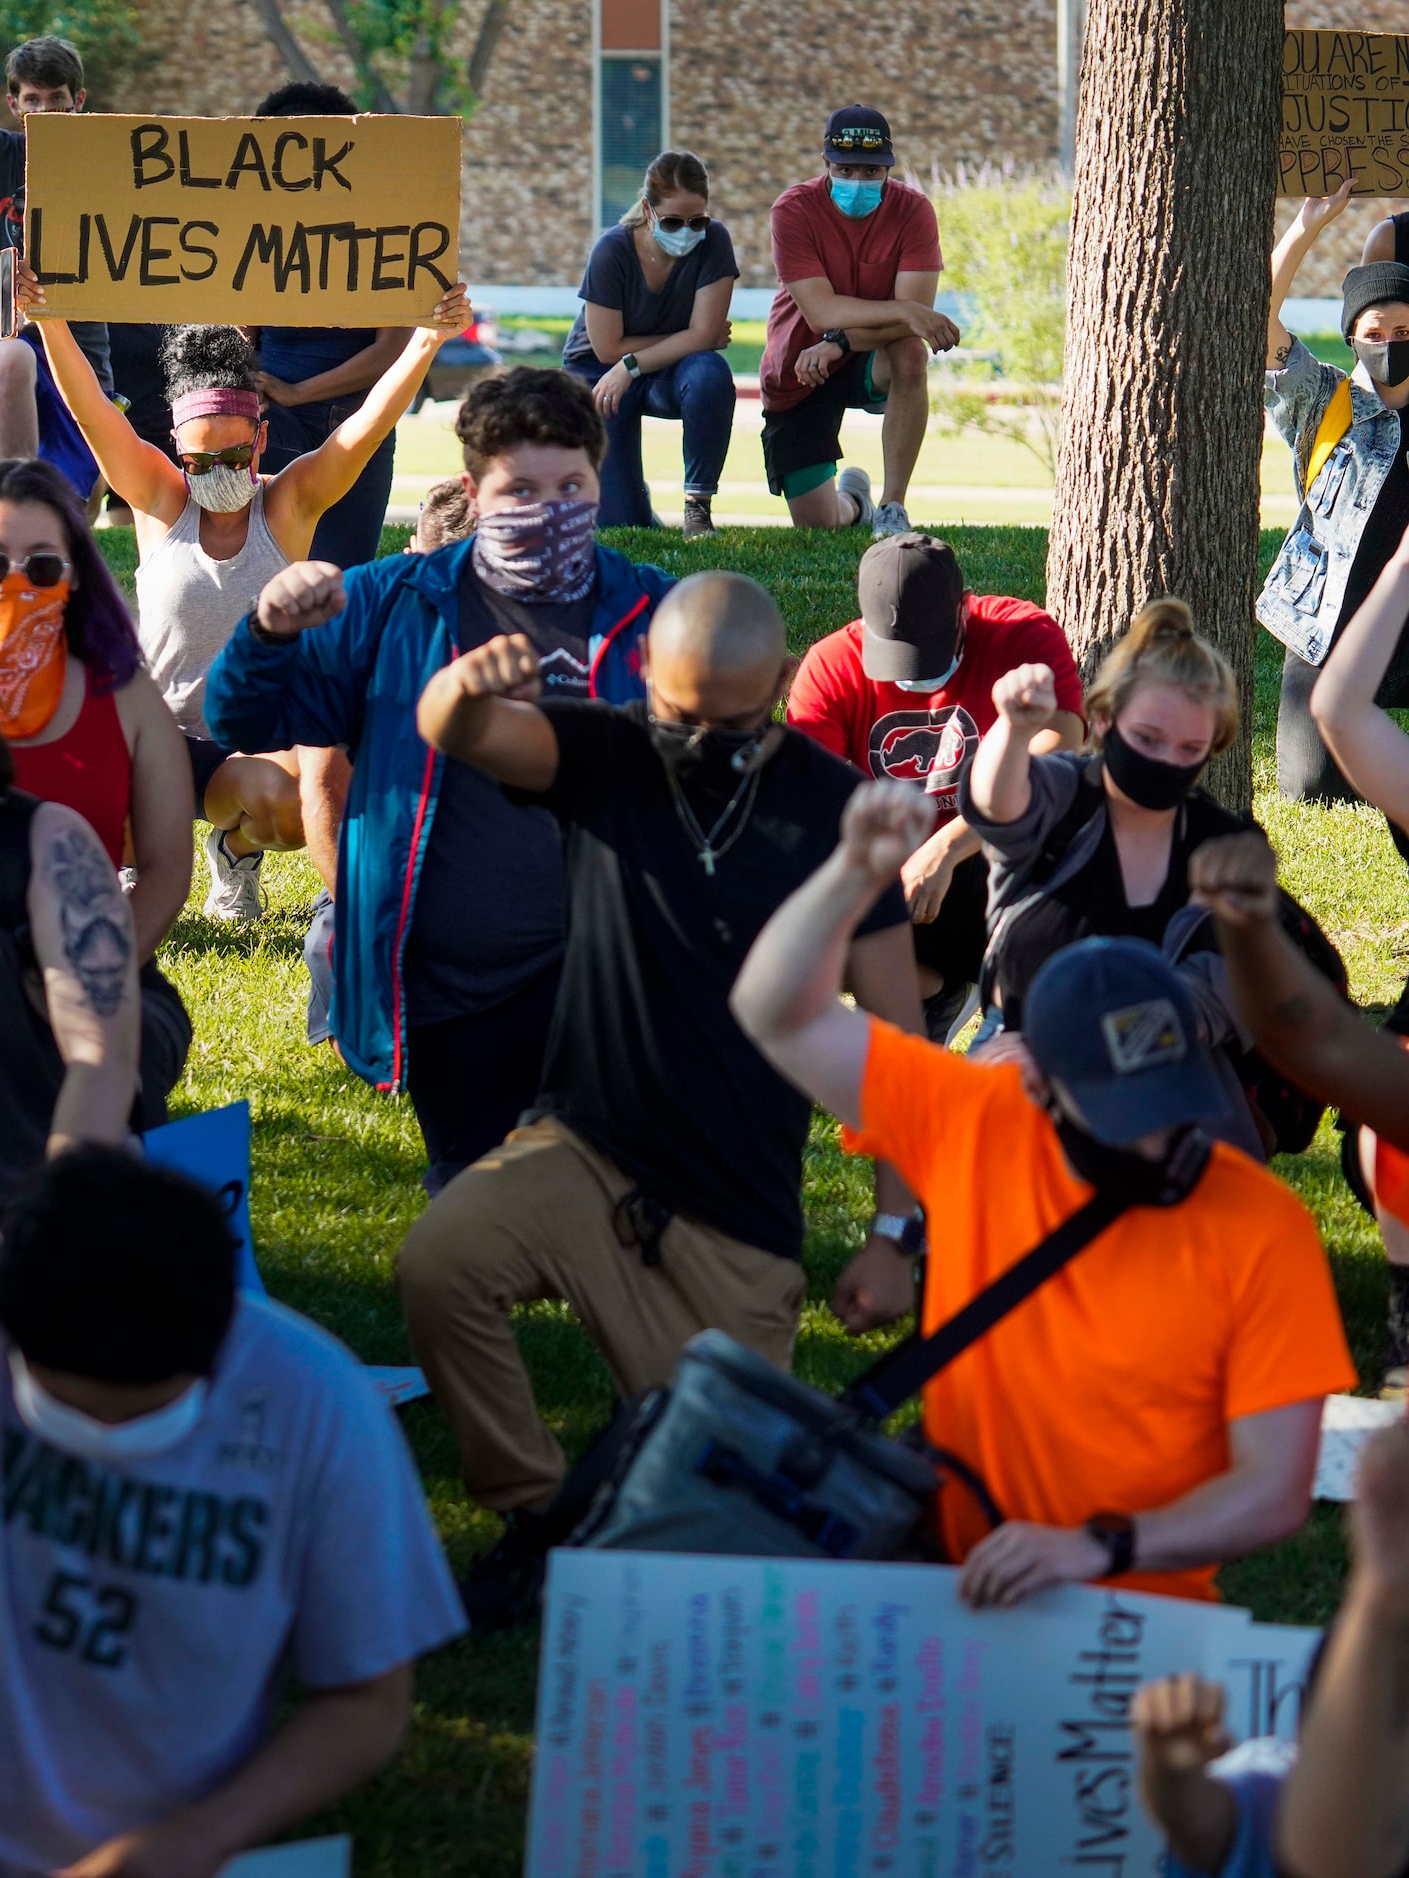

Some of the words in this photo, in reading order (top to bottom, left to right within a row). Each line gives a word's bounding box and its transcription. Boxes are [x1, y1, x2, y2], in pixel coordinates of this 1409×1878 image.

[1282, 31, 1320, 75] OU
[1327, 32, 1387, 75] ARE
[1282, 73, 1366, 92] ITUATIONS
[1376, 76, 1401, 92] OF
[1281, 94, 1409, 133] JUSTI
[1319, 135, 1366, 147] CHOSEN
[1369, 135, 1395, 147] THE
[129, 123, 356, 193] BLACK
[29, 206, 221, 286] LIVES
[232, 219, 453, 294] MATTER
[33, 1570, 138, 1669] 52
[977, 1722, 1017, 1863] SILENCE
